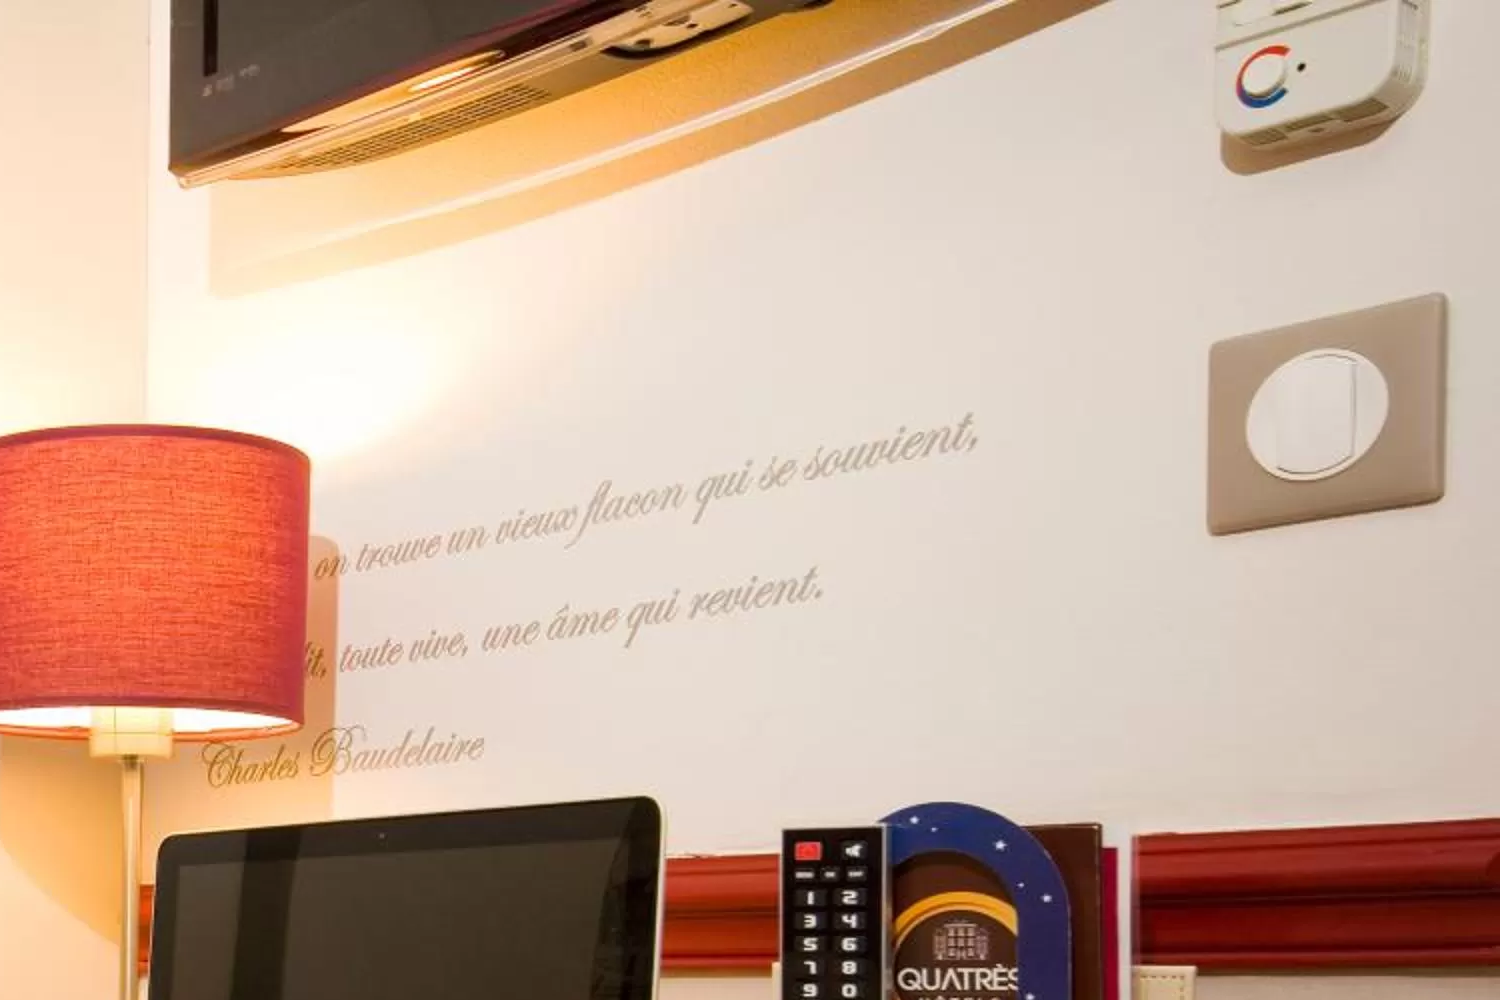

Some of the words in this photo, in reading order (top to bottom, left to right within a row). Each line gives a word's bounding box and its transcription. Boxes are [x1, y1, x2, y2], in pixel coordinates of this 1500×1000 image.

[314, 554, 349, 581] on
[356, 535, 442, 573] trouve
[447, 524, 492, 555] un
[495, 505, 578, 545] vieux
[564, 480, 687, 549] flacon
[694, 459, 755, 525] qui
[758, 455, 799, 491] se
[802, 412, 979, 481] souvient,
[339, 637, 404, 672] toute
[408, 629, 469, 663] vive,
[481, 618, 541, 651] une
[626, 588, 682, 649] qui
[687, 565, 824, 620] revient.
[202, 741, 300, 788] Charles
[309, 724, 485, 777] Baudelaire
[806, 890, 815, 905] 1
[841, 890, 859, 905] 2
[803, 913, 817, 929] 3
[841, 913, 858, 929] 4
[803, 937, 819, 952] 5
[841, 937, 858, 952] 6
[803, 960, 817, 975] 7
[841, 960, 858, 975] 8
[897, 963, 1019, 992] QUATRÈS
[803, 983, 818, 998] 9
[841, 983, 858, 999] 0
